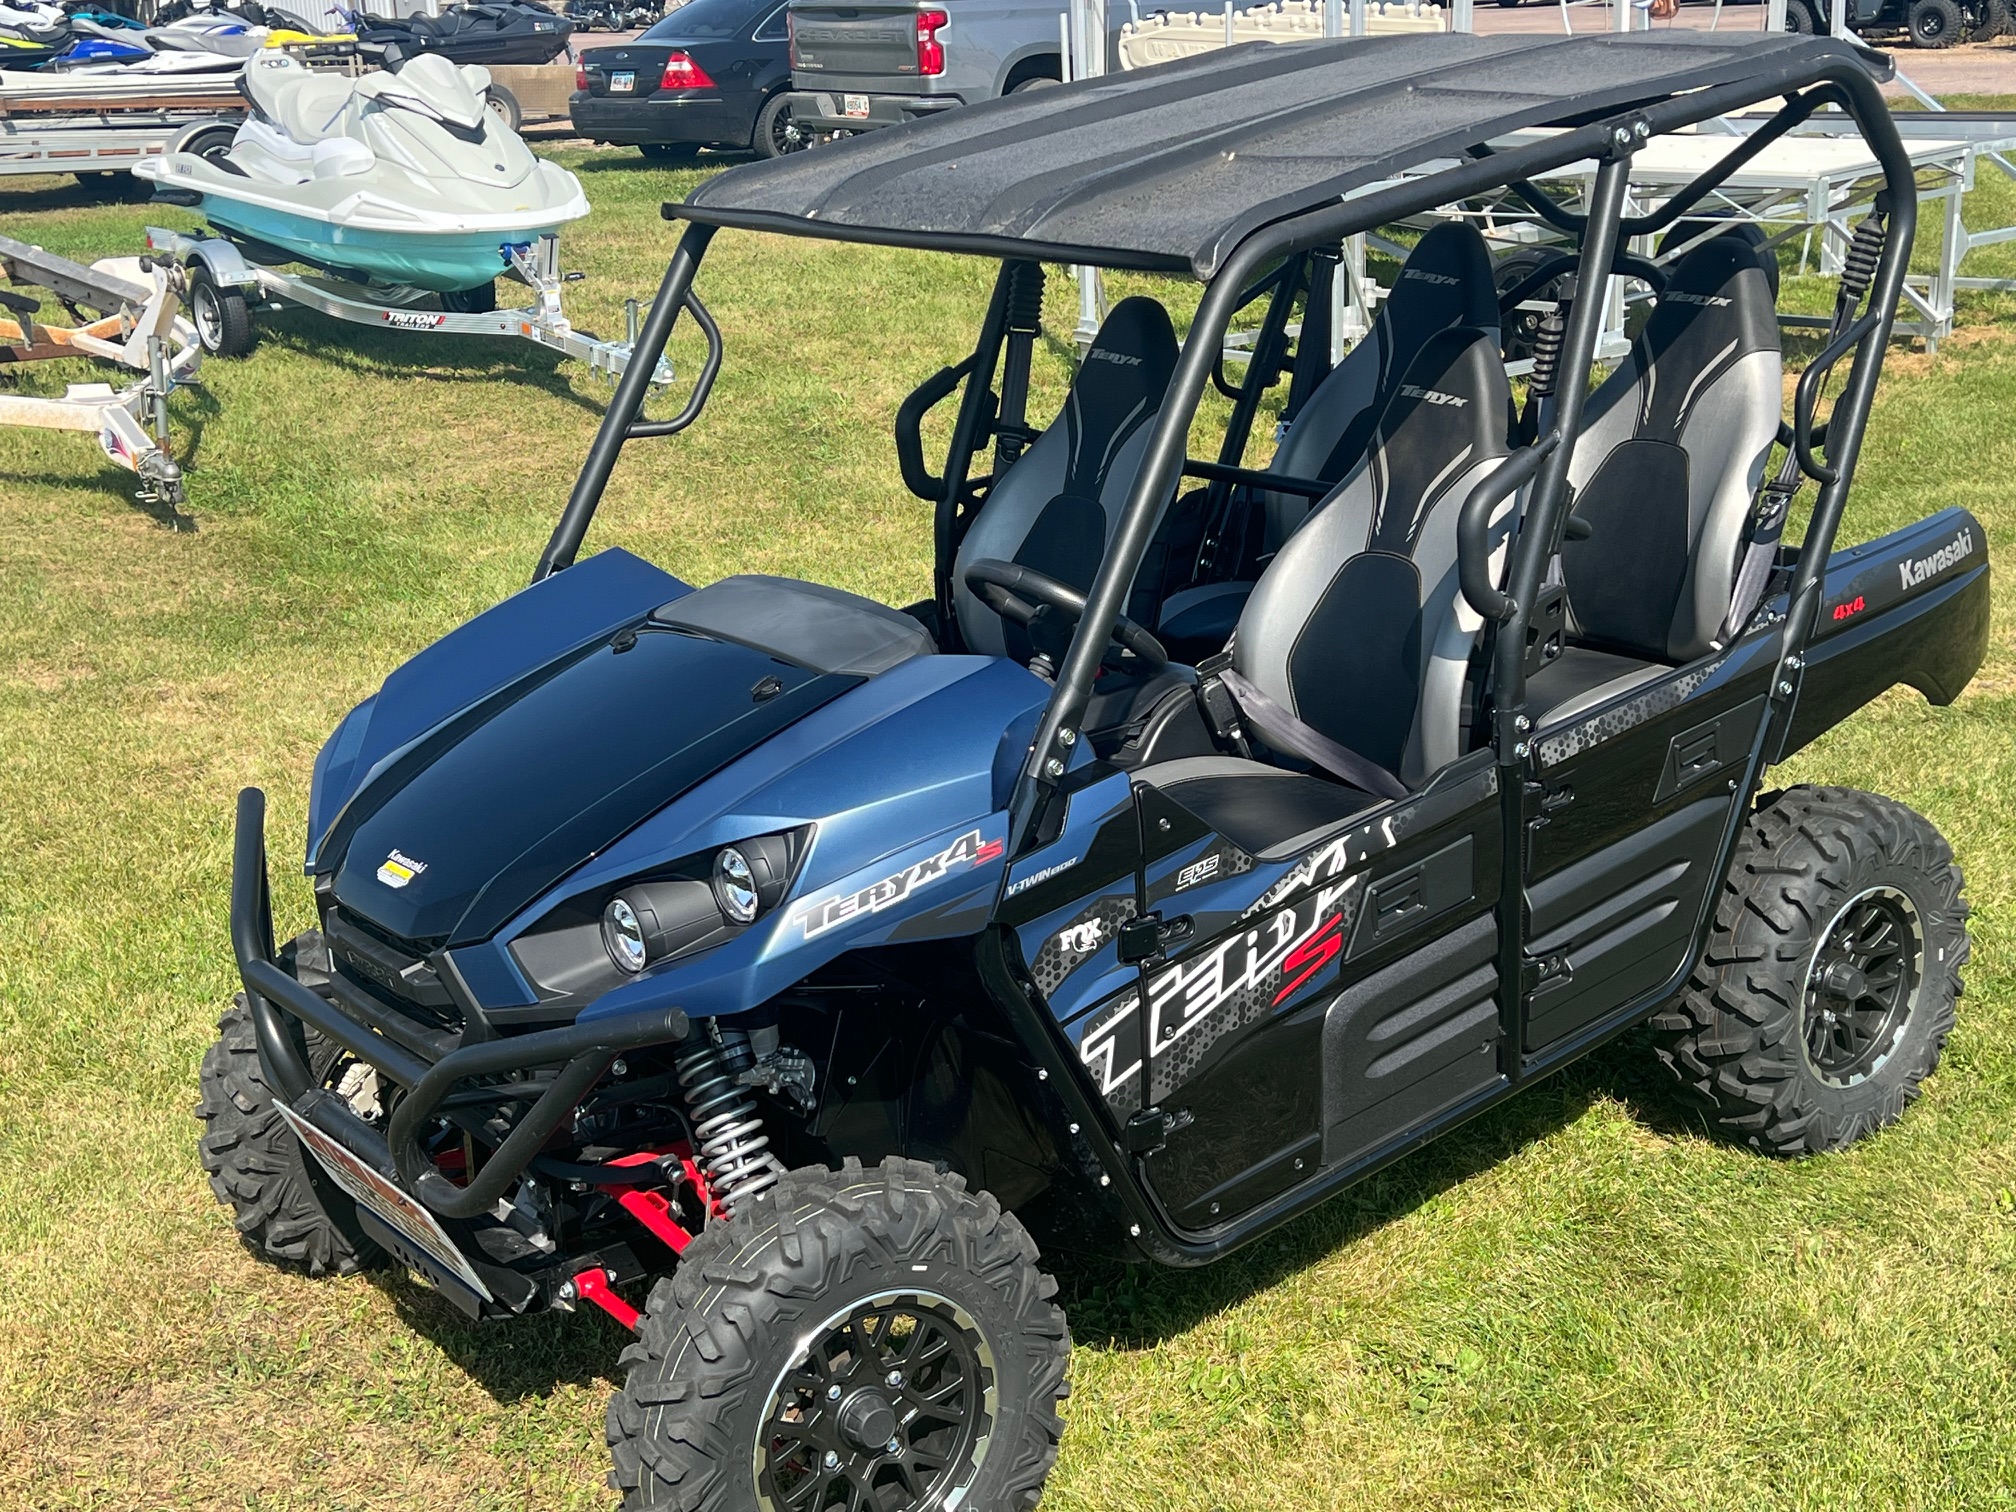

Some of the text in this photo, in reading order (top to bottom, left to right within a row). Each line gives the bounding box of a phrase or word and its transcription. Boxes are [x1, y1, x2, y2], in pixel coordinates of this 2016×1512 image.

[796, 29, 905, 42] CHEVROLET
[386, 311, 441, 326] TRITON
[1899, 526, 1974, 591] Kawasaki
[1833, 595, 1866, 621] 4x4
[387, 848, 429, 874] Kawasaki
[1175, 853, 1220, 892] EPS
[1059, 917, 1103, 953] FOX
